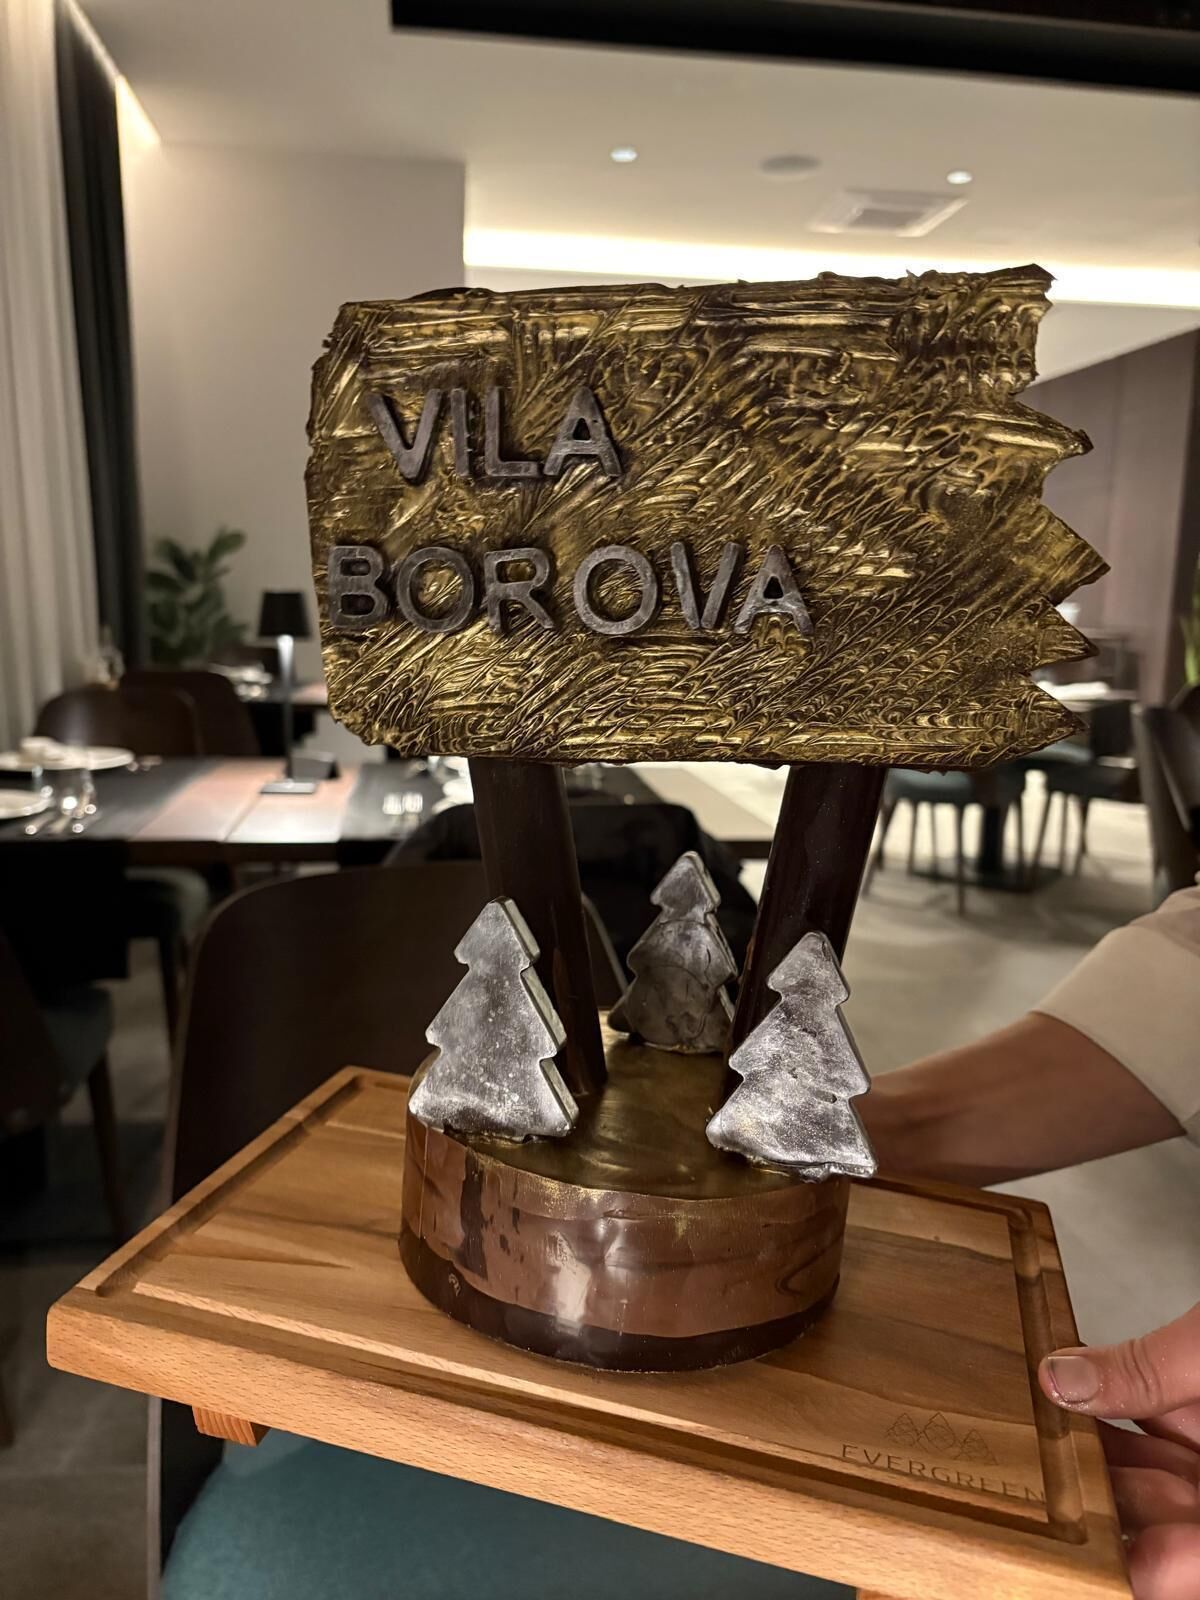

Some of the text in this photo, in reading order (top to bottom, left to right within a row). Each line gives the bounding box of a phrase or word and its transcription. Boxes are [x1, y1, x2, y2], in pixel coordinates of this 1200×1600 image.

[369, 386, 623, 481] VILA
[327, 541, 814, 636] BOROVA
[841, 1443, 1047, 1504] EVERGREEN
